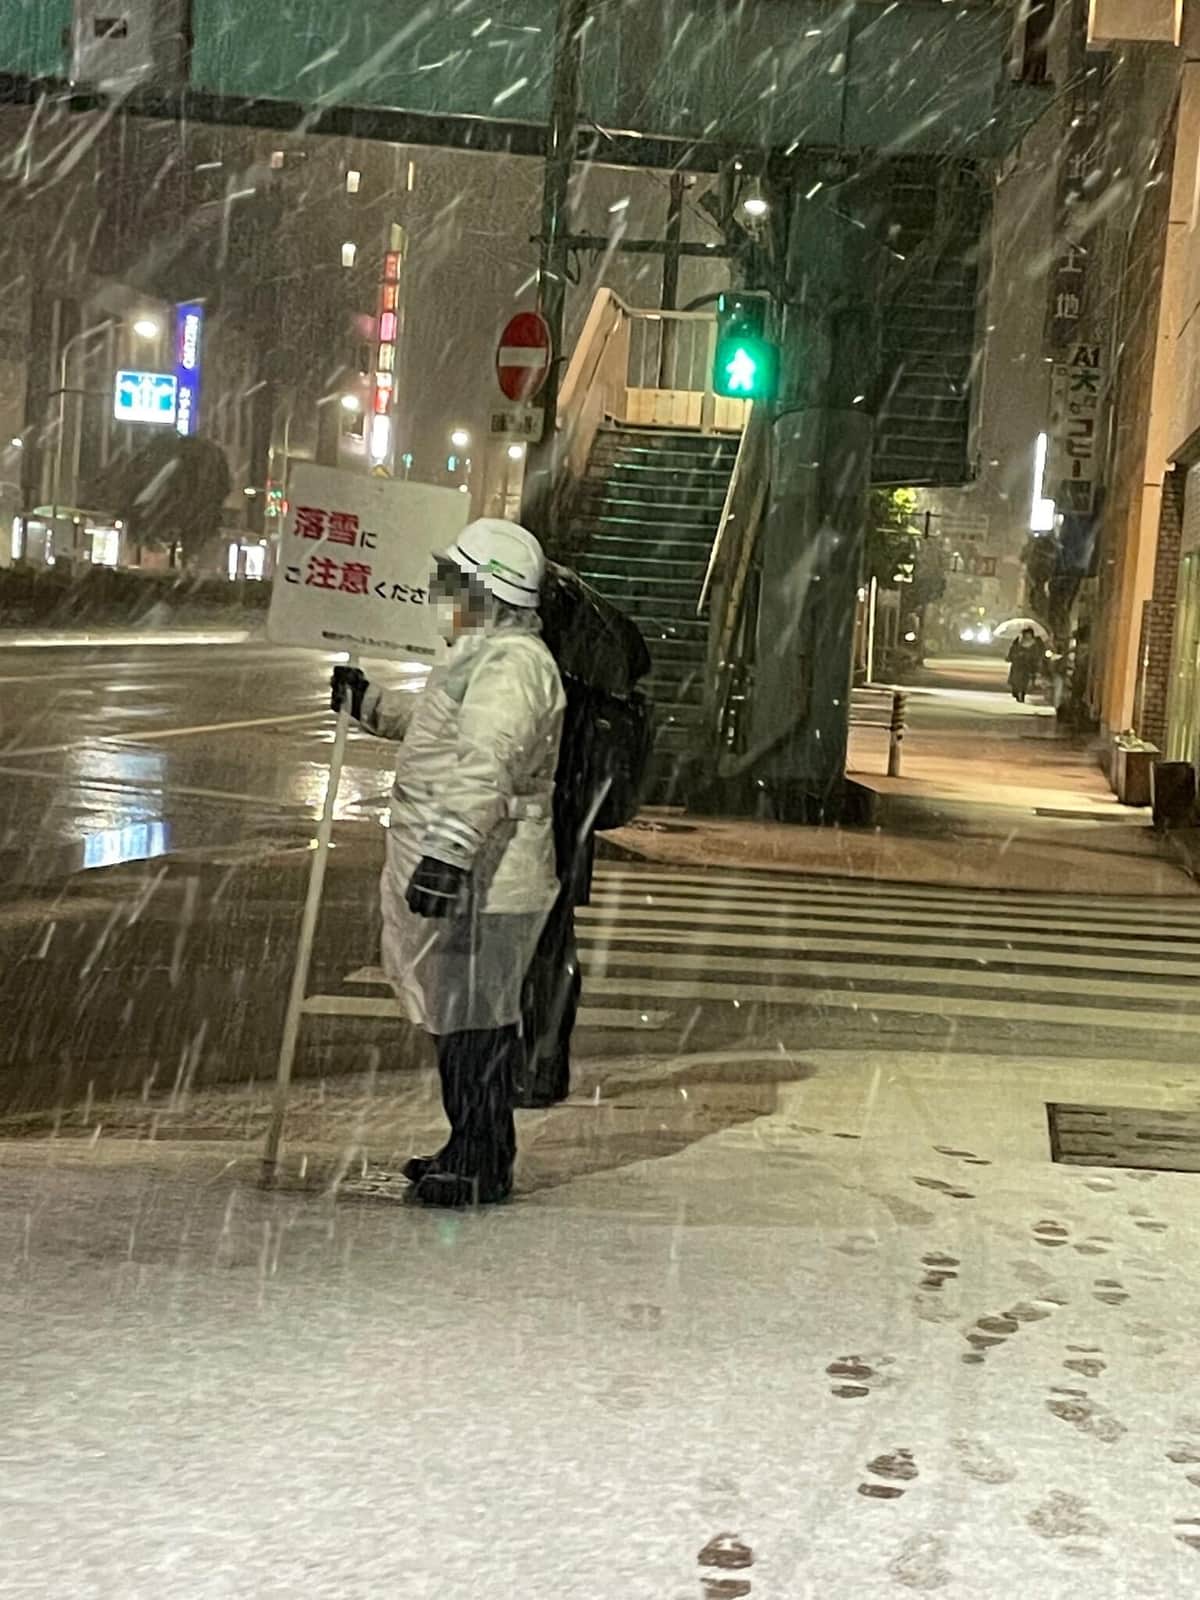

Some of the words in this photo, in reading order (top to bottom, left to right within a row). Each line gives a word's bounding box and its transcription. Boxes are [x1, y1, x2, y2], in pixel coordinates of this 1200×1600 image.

[293, 506, 378, 549] 落雪に
[284, 555, 431, 605] ご注意くださ
